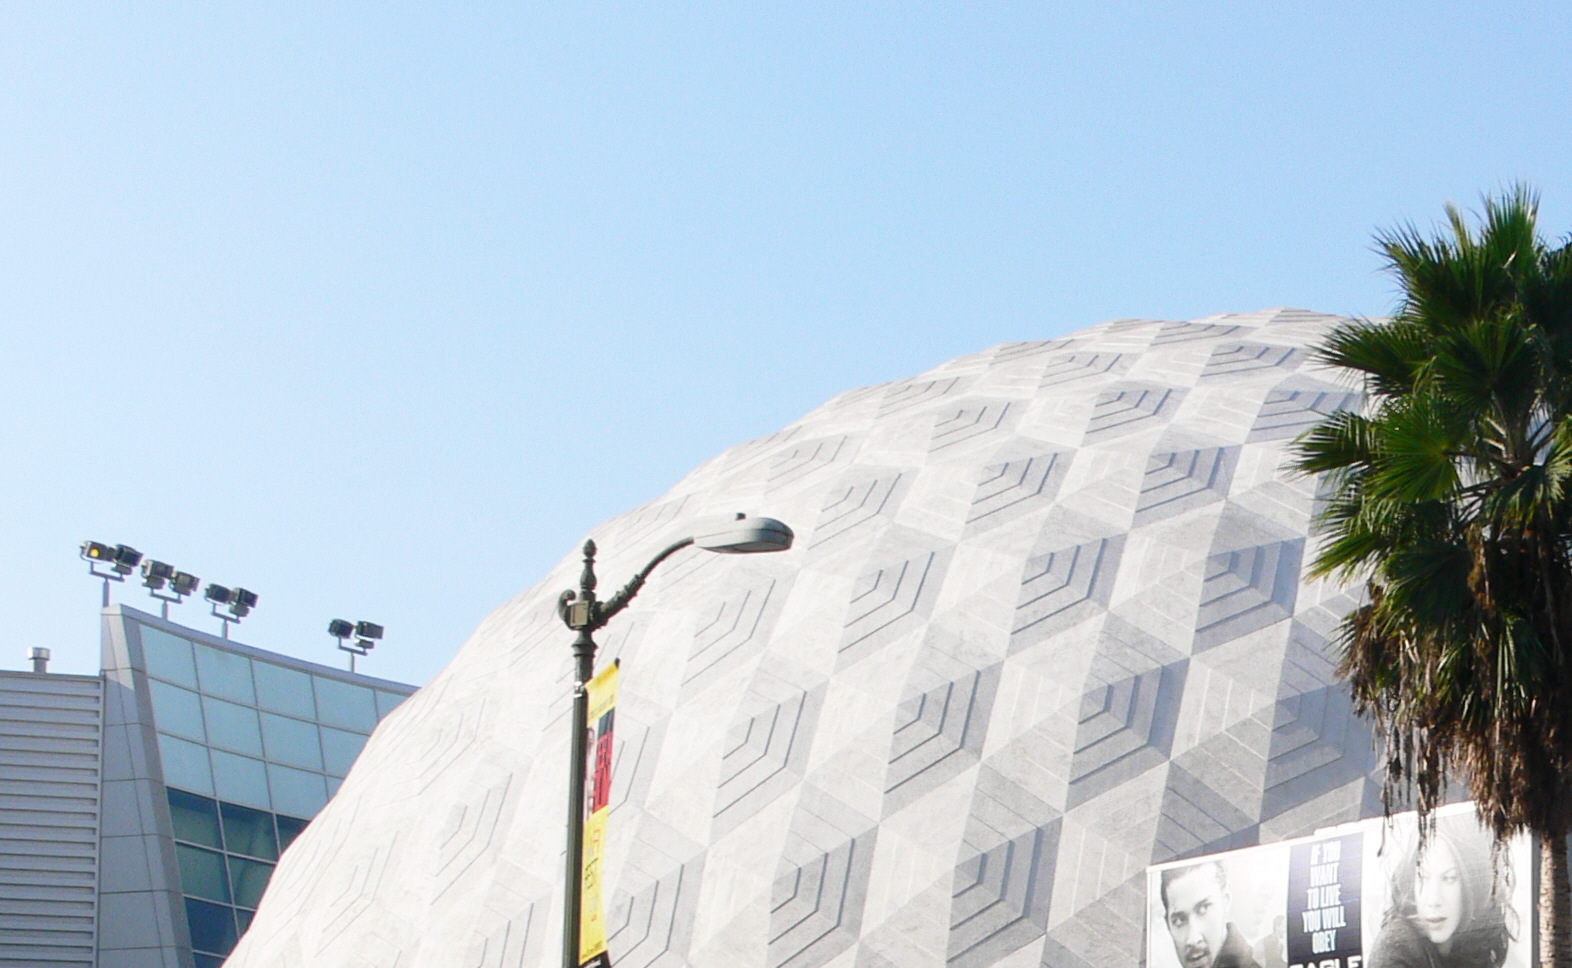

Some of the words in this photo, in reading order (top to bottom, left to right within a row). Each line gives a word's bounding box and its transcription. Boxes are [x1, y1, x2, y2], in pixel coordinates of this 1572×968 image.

[1310, 844, 1321, 866] IF
[1323, 840, 1341, 863] YOU
[1310, 862, 1339, 888] WANT
[1307, 887, 1320, 910] TO
[1320, 884, 1342, 908] LIVE
[1302, 910, 1321, 933] YOU
[1322, 905, 1346, 929] WILL
[1312, 929, 1337, 955] OBEY
